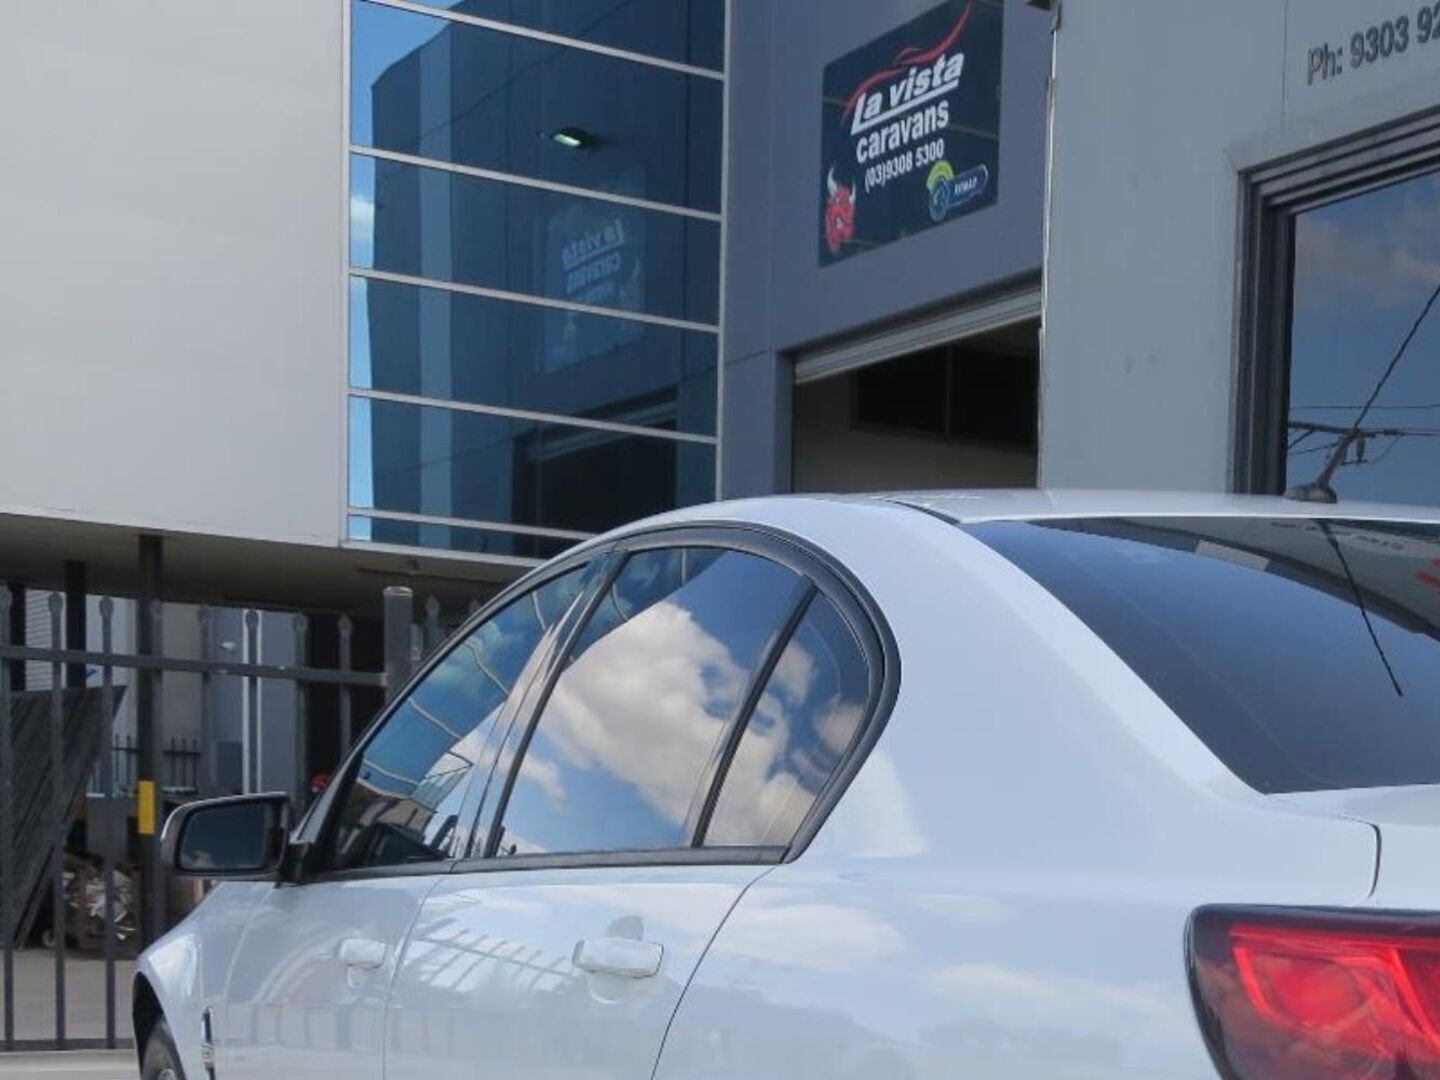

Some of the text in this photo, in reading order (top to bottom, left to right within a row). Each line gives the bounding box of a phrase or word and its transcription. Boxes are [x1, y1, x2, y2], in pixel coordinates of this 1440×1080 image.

[1307, 43, 1343, 86] Ph:
[1350, 15, 1410, 69] 9303
[851, 52, 966, 135] La vista
[856, 100, 949, 164] caravans
[915, 138, 945, 168] 5300
